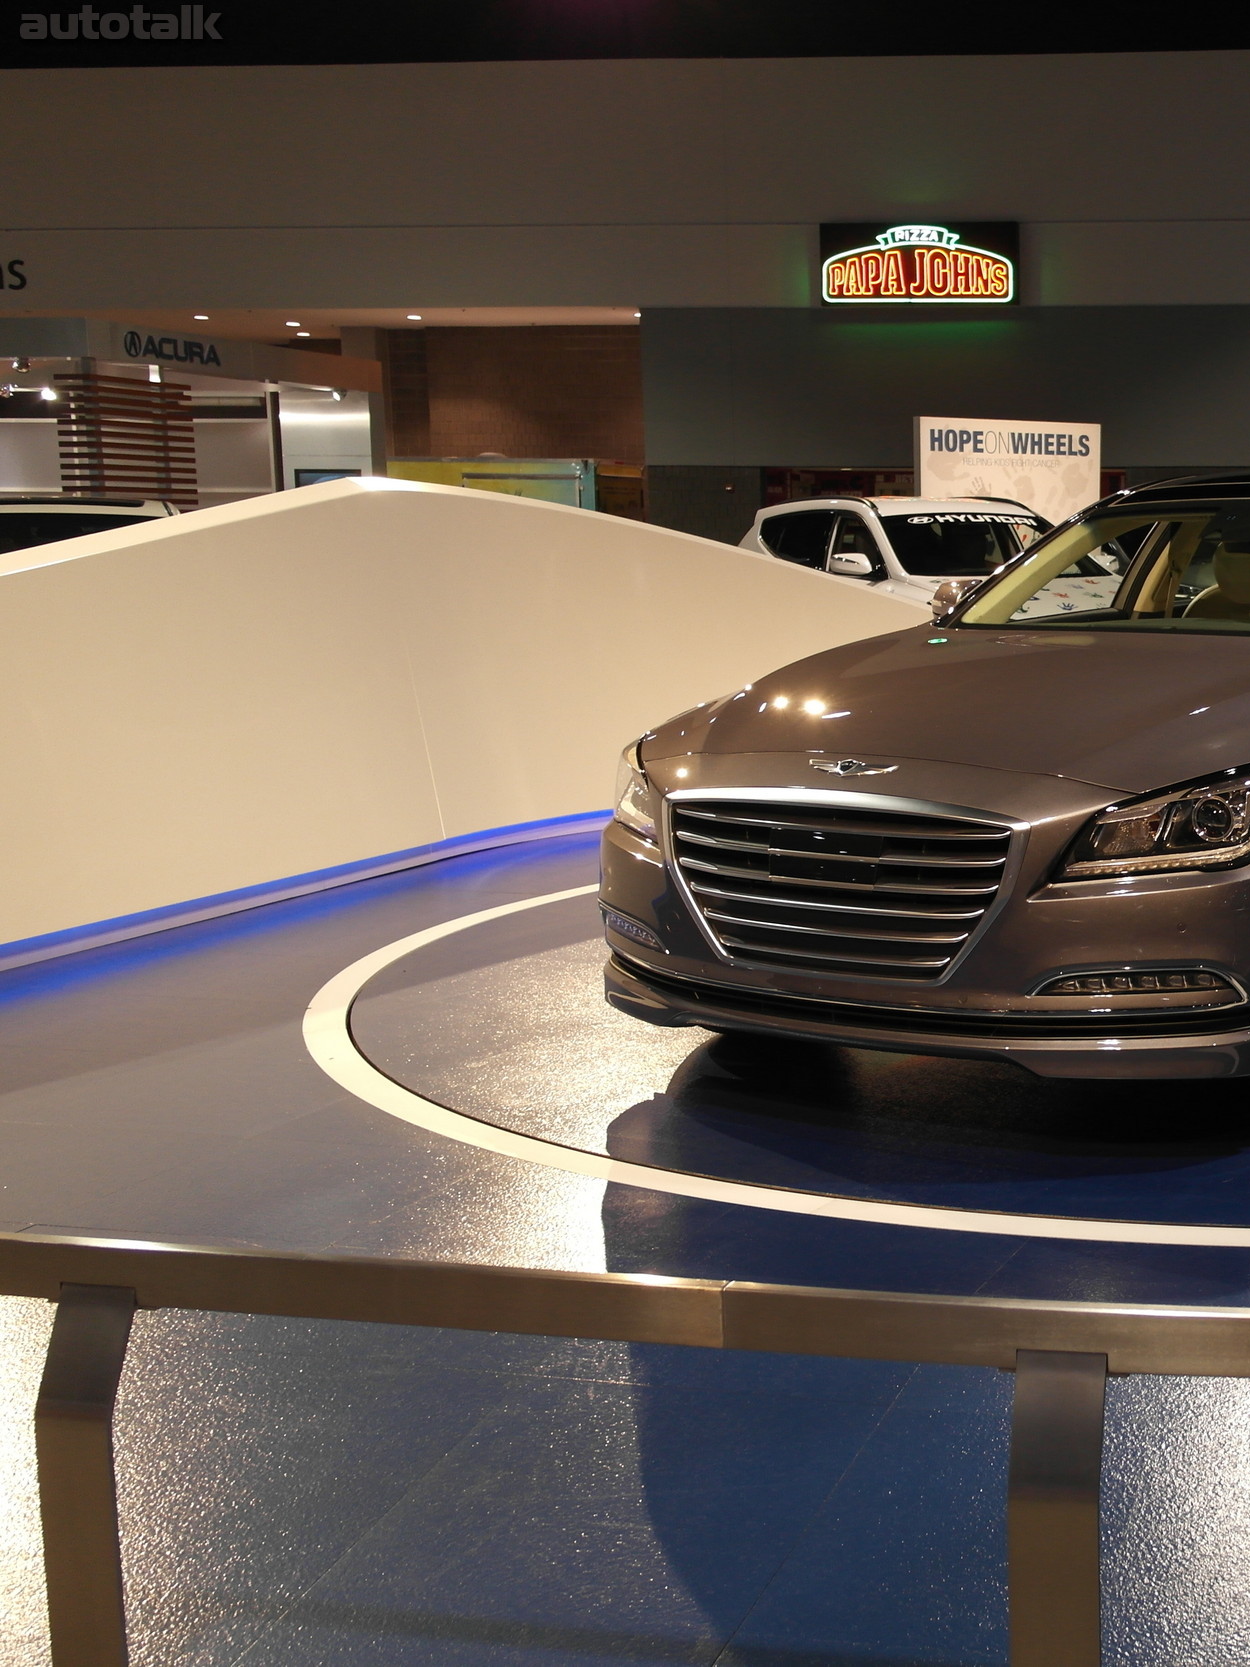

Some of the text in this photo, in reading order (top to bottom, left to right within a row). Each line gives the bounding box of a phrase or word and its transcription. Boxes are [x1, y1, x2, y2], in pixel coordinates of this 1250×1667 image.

[894, 229, 939, 242] PIZZA
[829, 251, 906, 295] PAPA
[142, 335, 221, 367] ACURA
[963, 457, 1060, 469] HELPING KIDS FIGHT CANCER
[935, 514, 1038, 527] HYUNDAI
